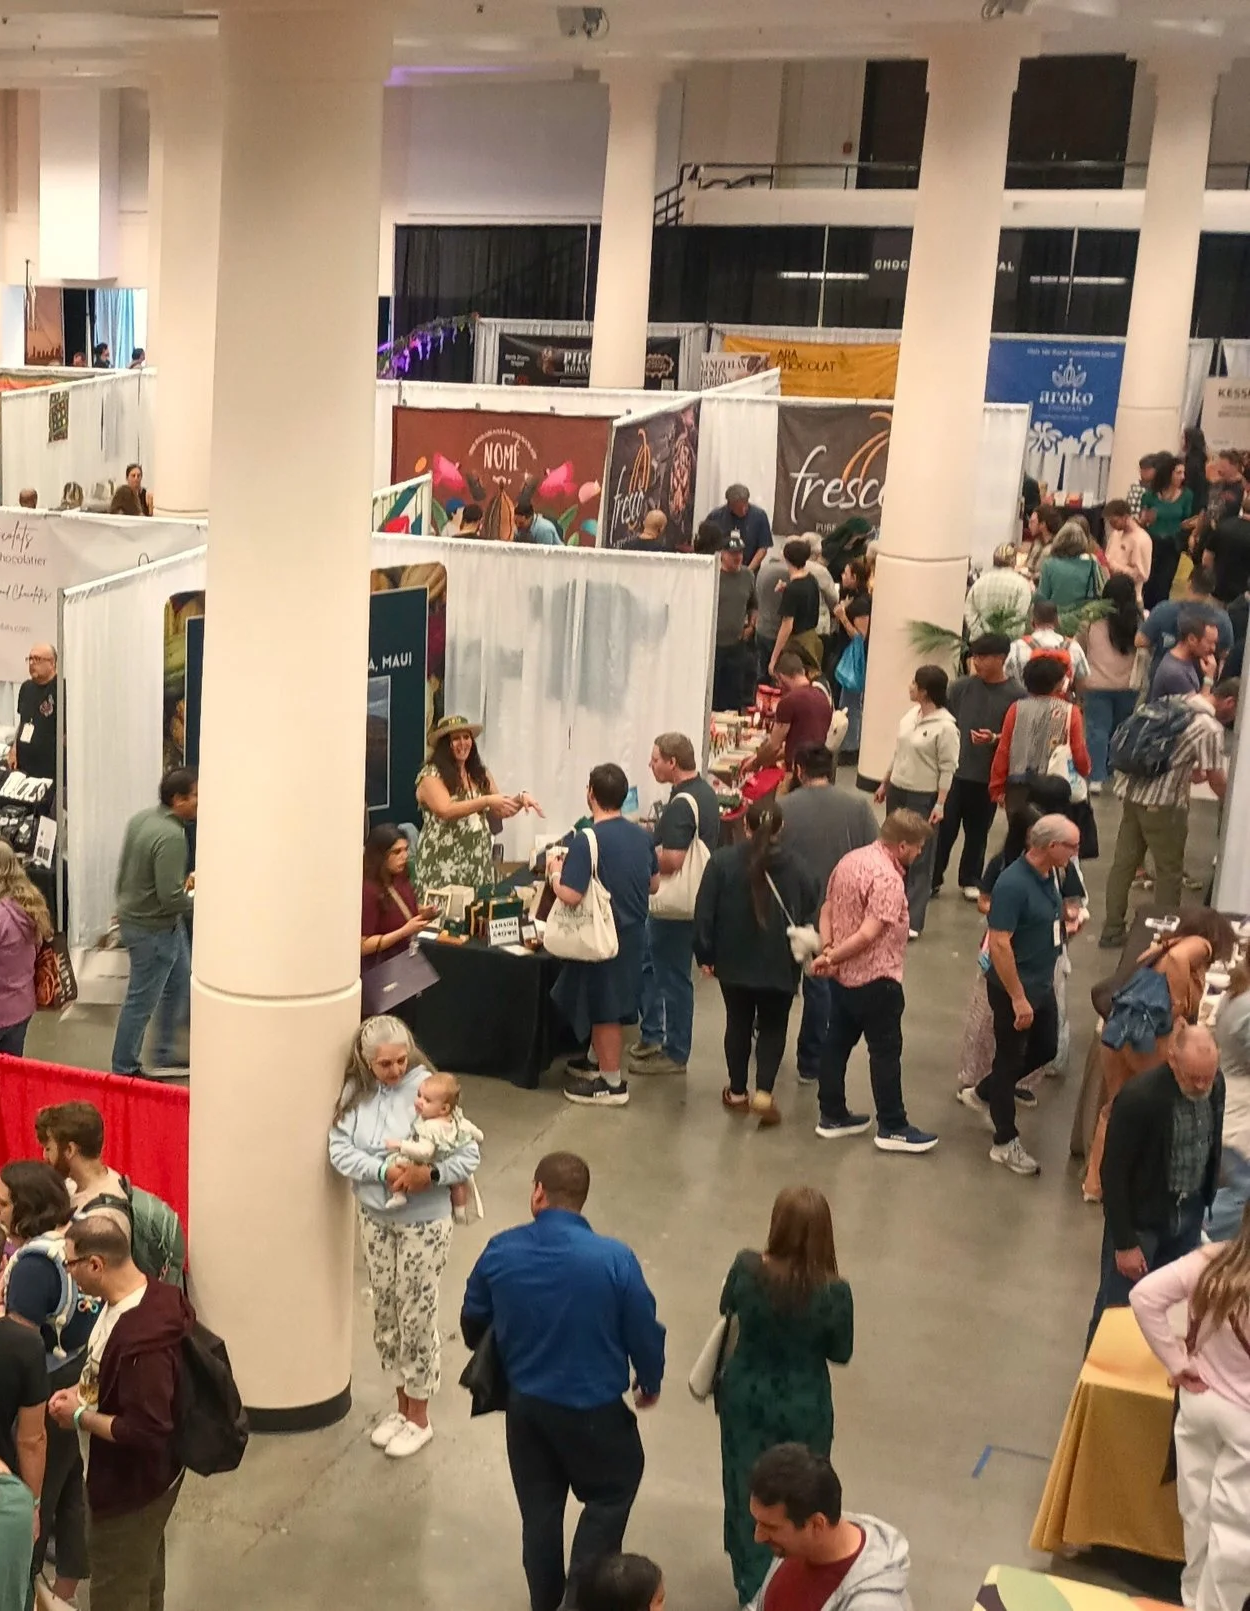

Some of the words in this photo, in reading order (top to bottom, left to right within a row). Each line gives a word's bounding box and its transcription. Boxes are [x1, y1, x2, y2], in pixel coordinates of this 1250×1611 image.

[776, 360, 836, 372] CHOCOLAT
[1039, 388, 1094, 405] aroko
[382, 652, 412, 670] MAUI
